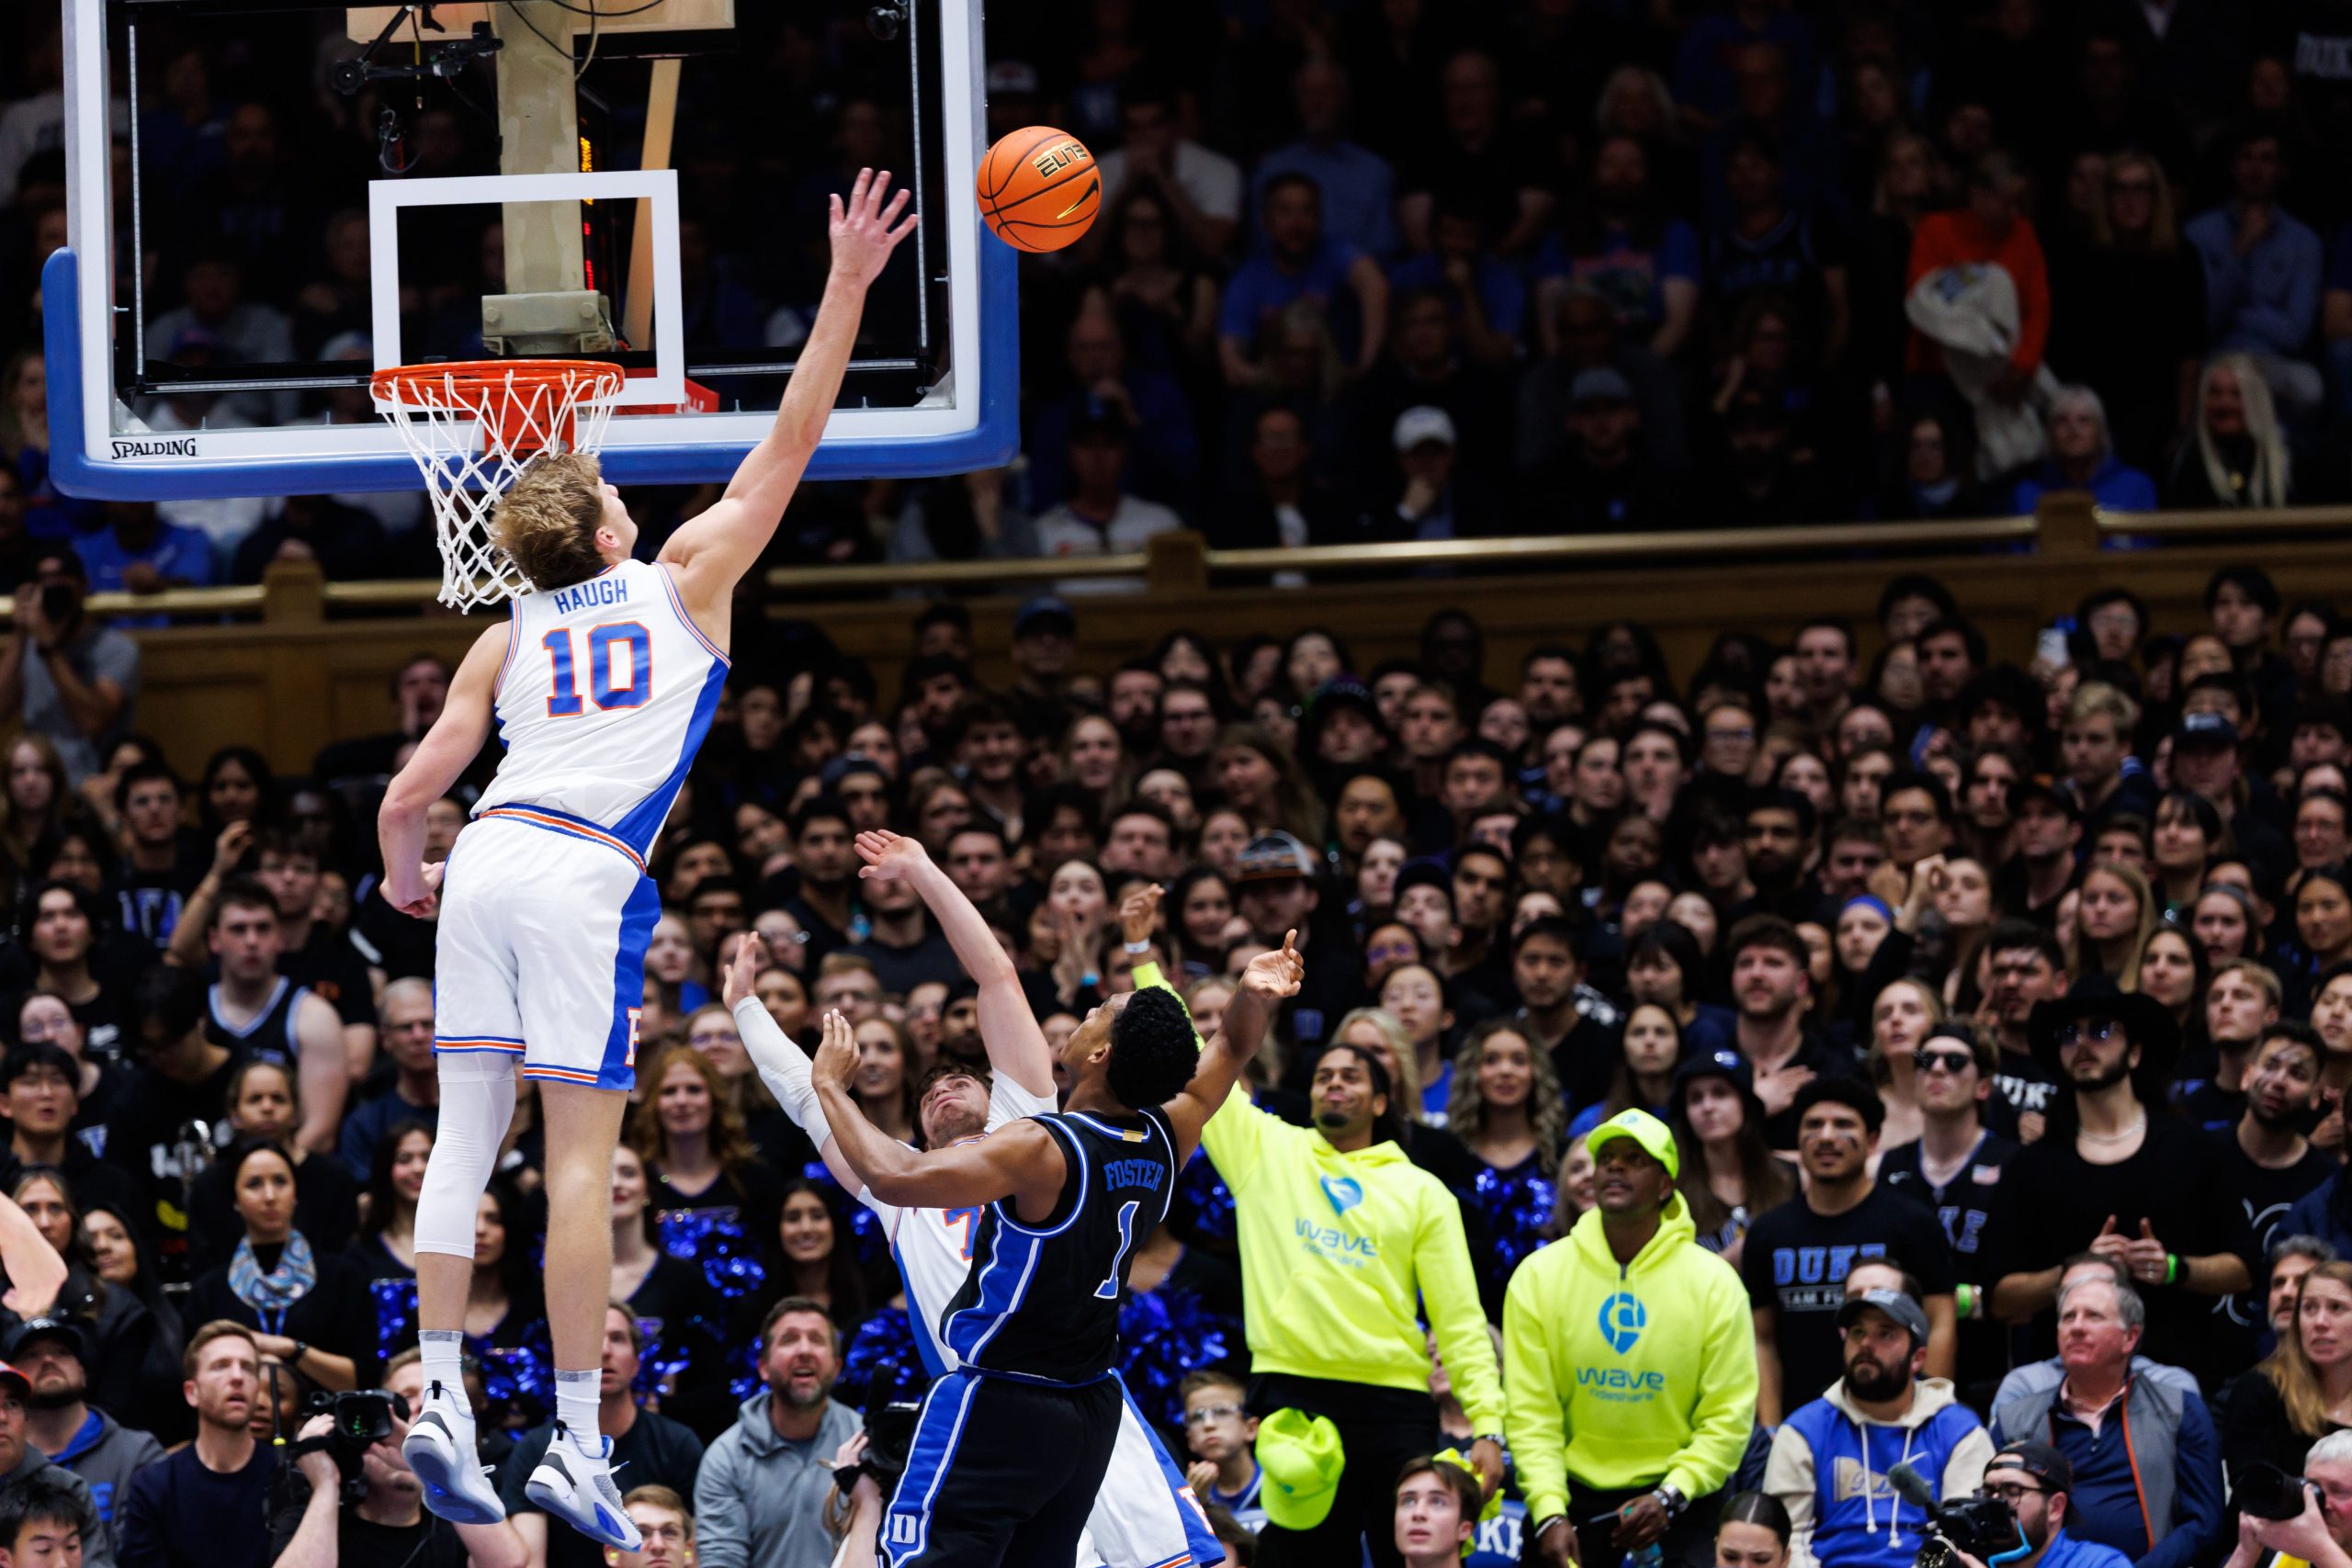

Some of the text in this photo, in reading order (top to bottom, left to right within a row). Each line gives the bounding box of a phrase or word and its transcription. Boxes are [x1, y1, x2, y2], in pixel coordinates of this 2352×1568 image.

[1035, 142, 1089, 178] ELITE
[111, 437, 198, 460] SPALDING
[554, 579, 628, 615] HAUGH
[541, 620, 652, 718] 10
[1102, 1158, 1165, 1192] FOSTER
[943, 1205, 983, 1261] 7
[1093, 1201, 1140, 1299] 1
[1295, 1217, 1377, 1257] wave
[1577, 1367, 1665, 1392] wave
[890, 1513, 917, 1544] D
